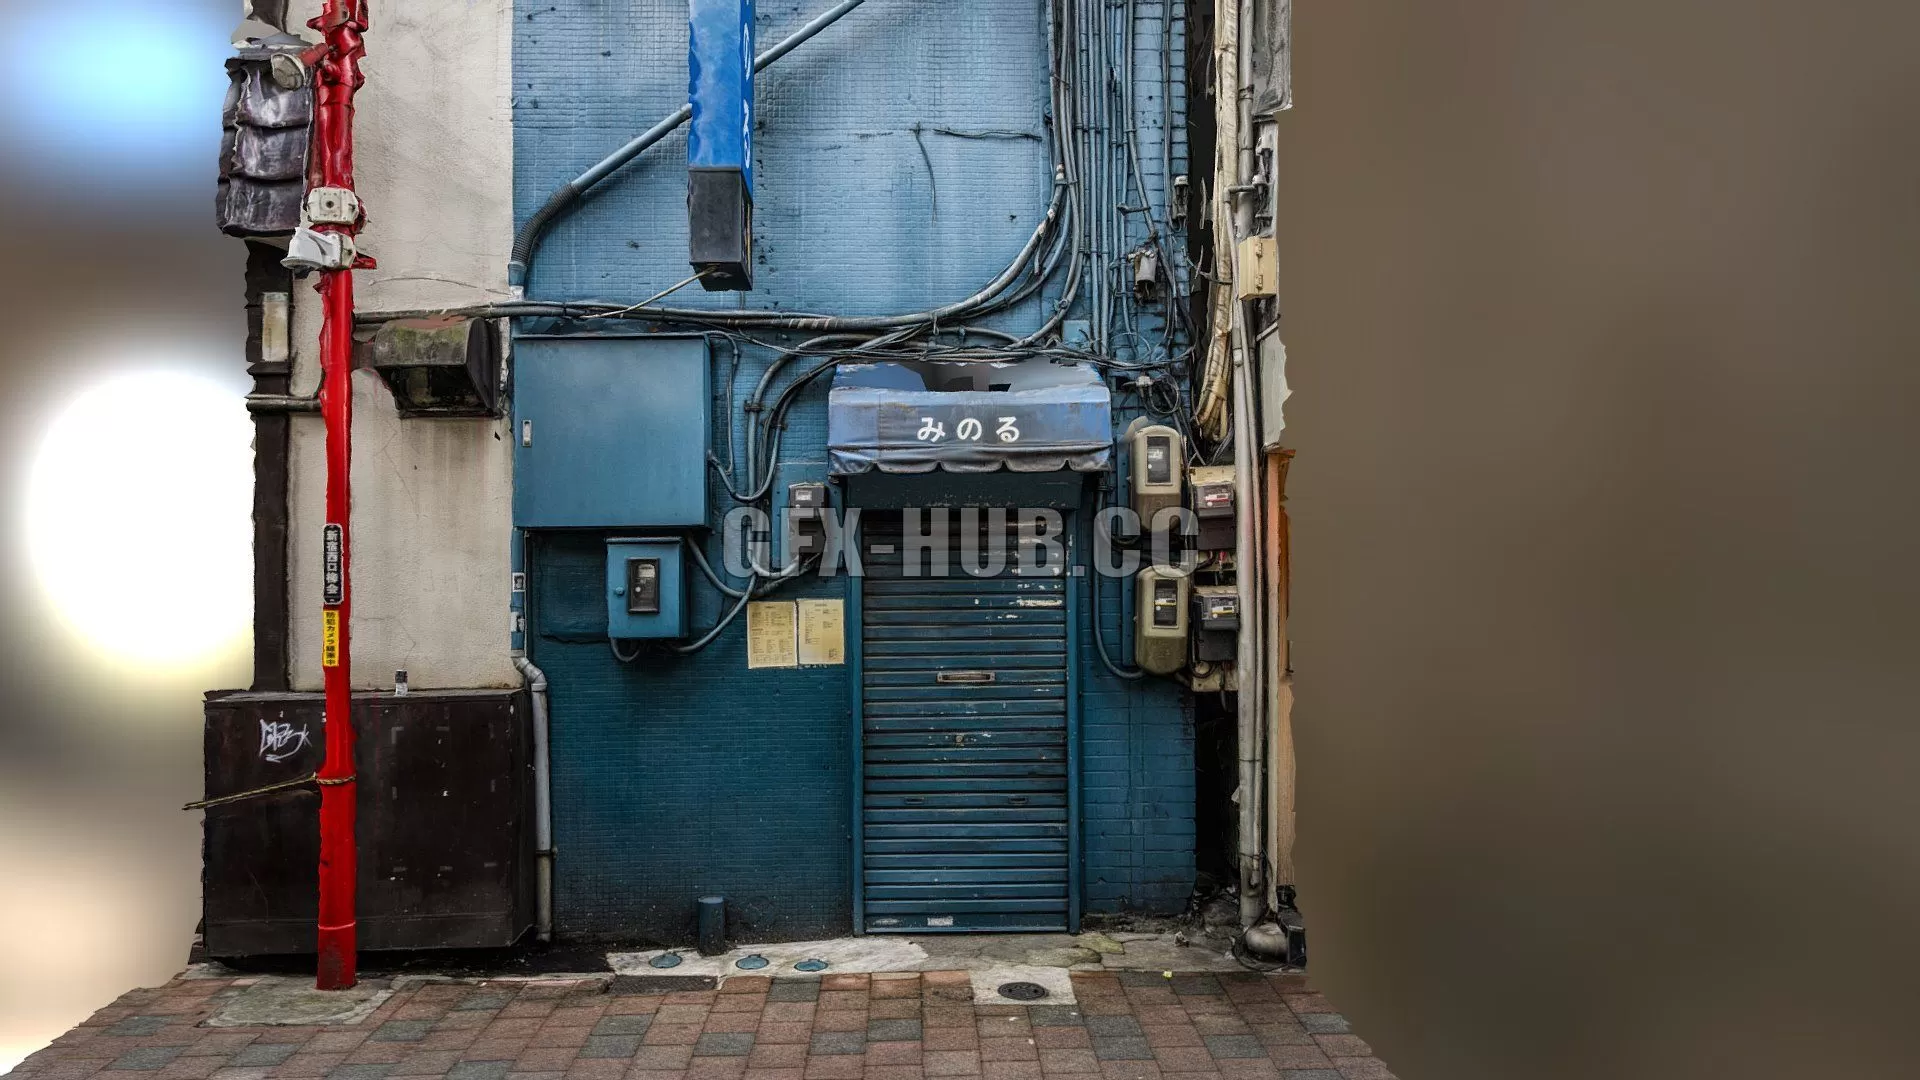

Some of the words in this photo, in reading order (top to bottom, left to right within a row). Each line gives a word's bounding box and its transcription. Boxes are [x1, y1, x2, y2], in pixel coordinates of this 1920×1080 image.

[743, 0, 751, 169] のる
[917, 416, 1020, 442] みのる
